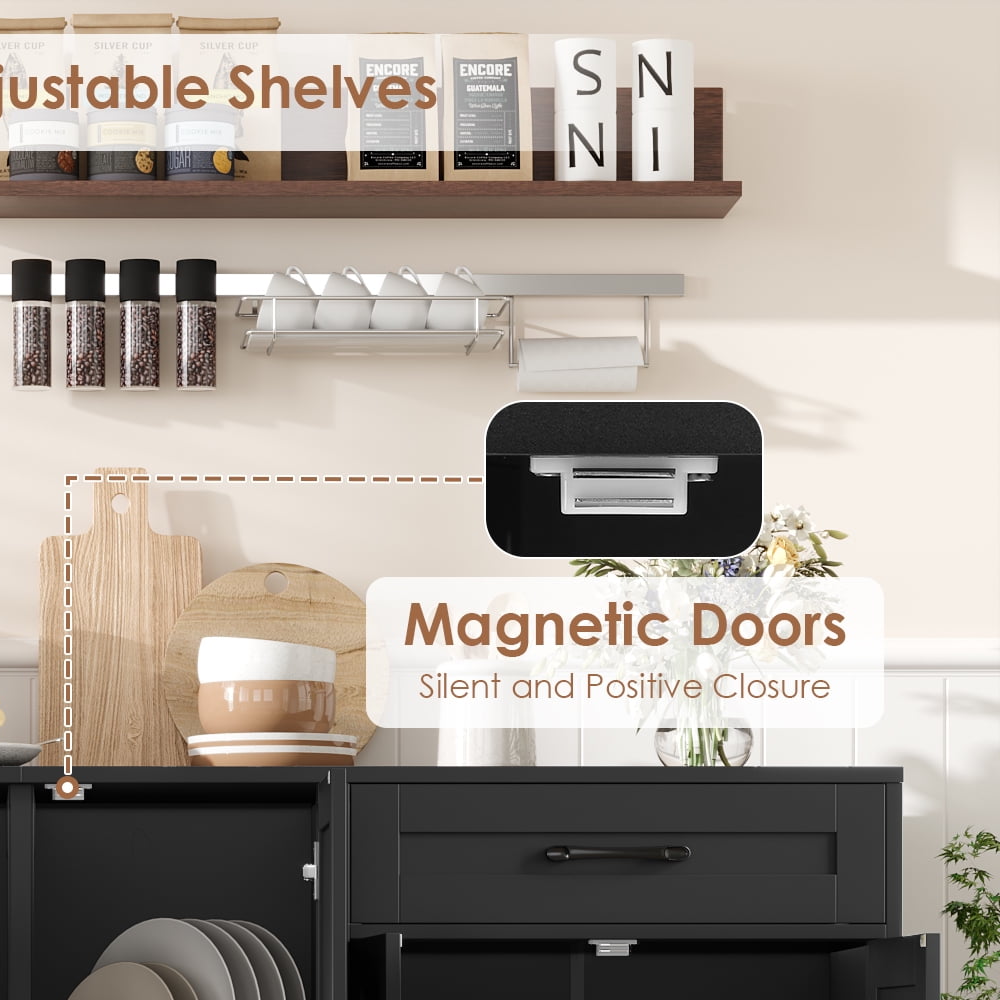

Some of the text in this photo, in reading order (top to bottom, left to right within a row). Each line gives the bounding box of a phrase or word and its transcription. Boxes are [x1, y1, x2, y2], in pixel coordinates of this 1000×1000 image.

[23, 41, 46, 50] CUP
[93, 41, 153, 50] SILVER CUP
[199, 41, 259, 50] SILVER CUP
[365, 63, 420, 77] ENCORE
[459, 63, 513, 77] ENCORE
[572, 48, 603, 96] S
[637, 50, 673, 98] N
[466, 84, 506, 92] GUATEMALA
[567, 121, 605, 168] N
